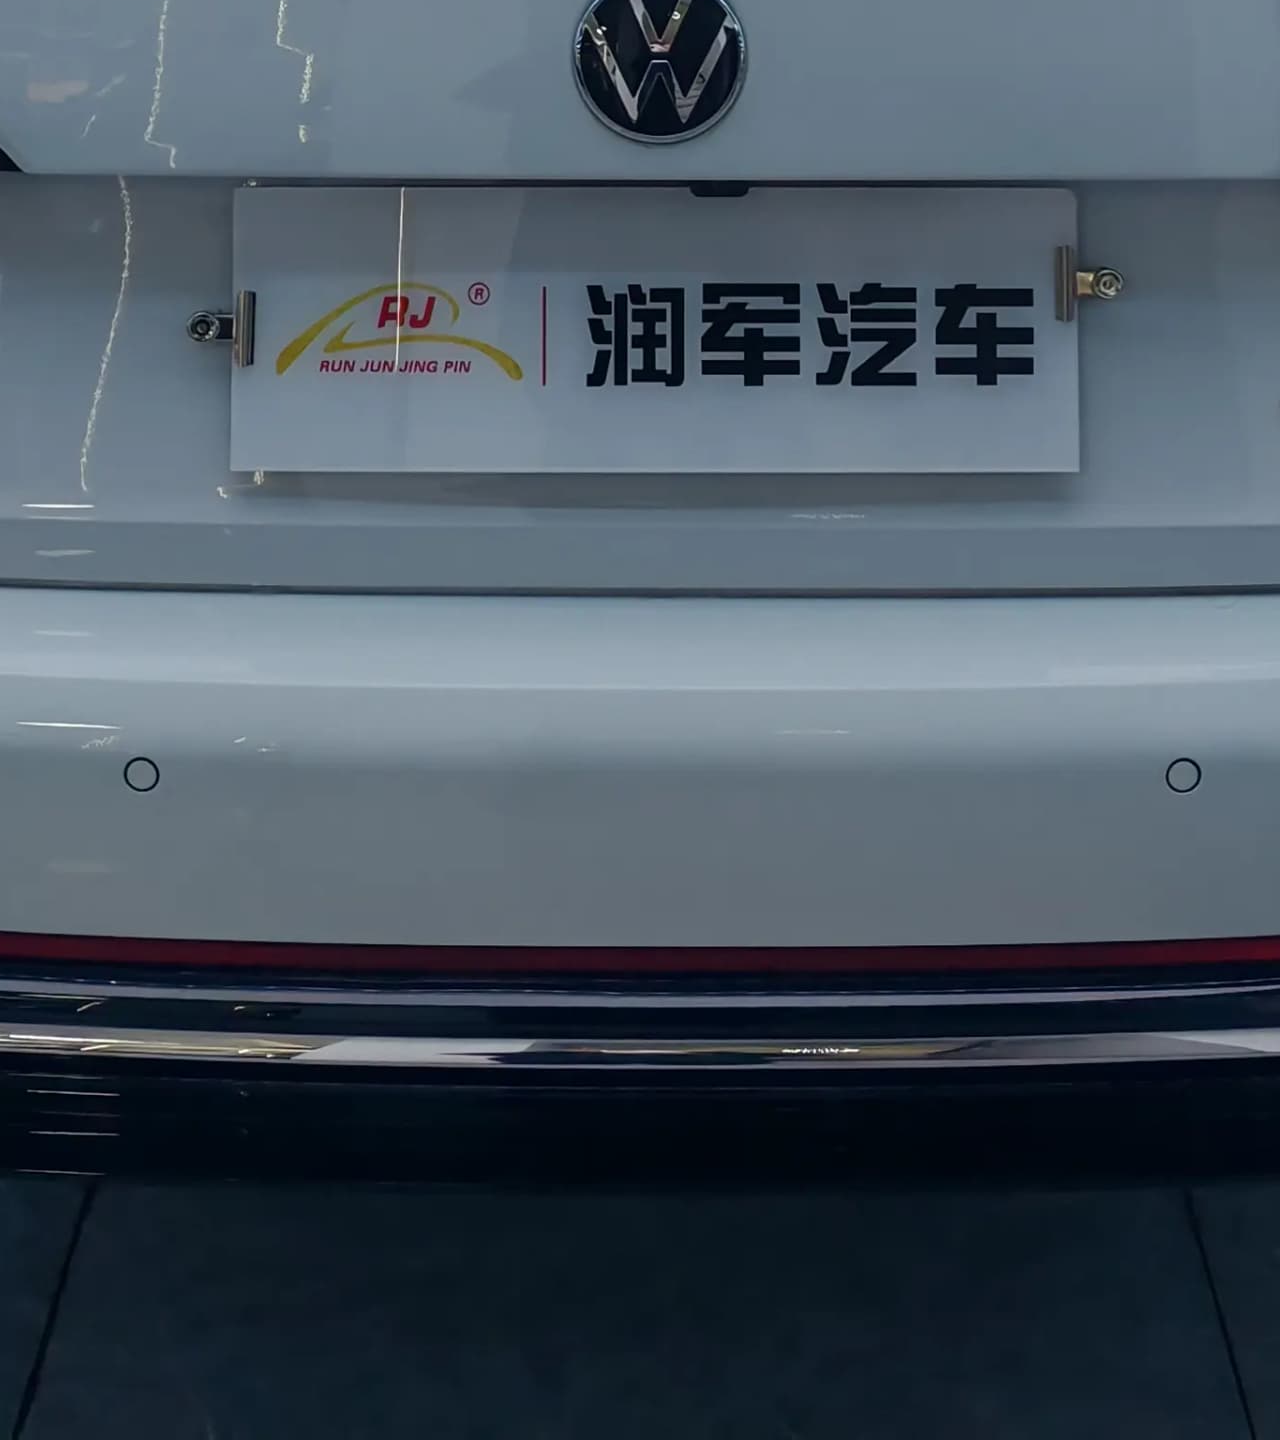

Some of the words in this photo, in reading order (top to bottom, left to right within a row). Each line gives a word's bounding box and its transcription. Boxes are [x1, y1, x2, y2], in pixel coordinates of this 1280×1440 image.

[377, 296, 436, 329] RJ
[586, 283, 1034, 387] 润军汽车
[319, 360, 355, 373] RUN
[360, 360, 395, 373] JUN
[399, 360, 437, 373] JING
[443, 360, 472, 373] PIN
